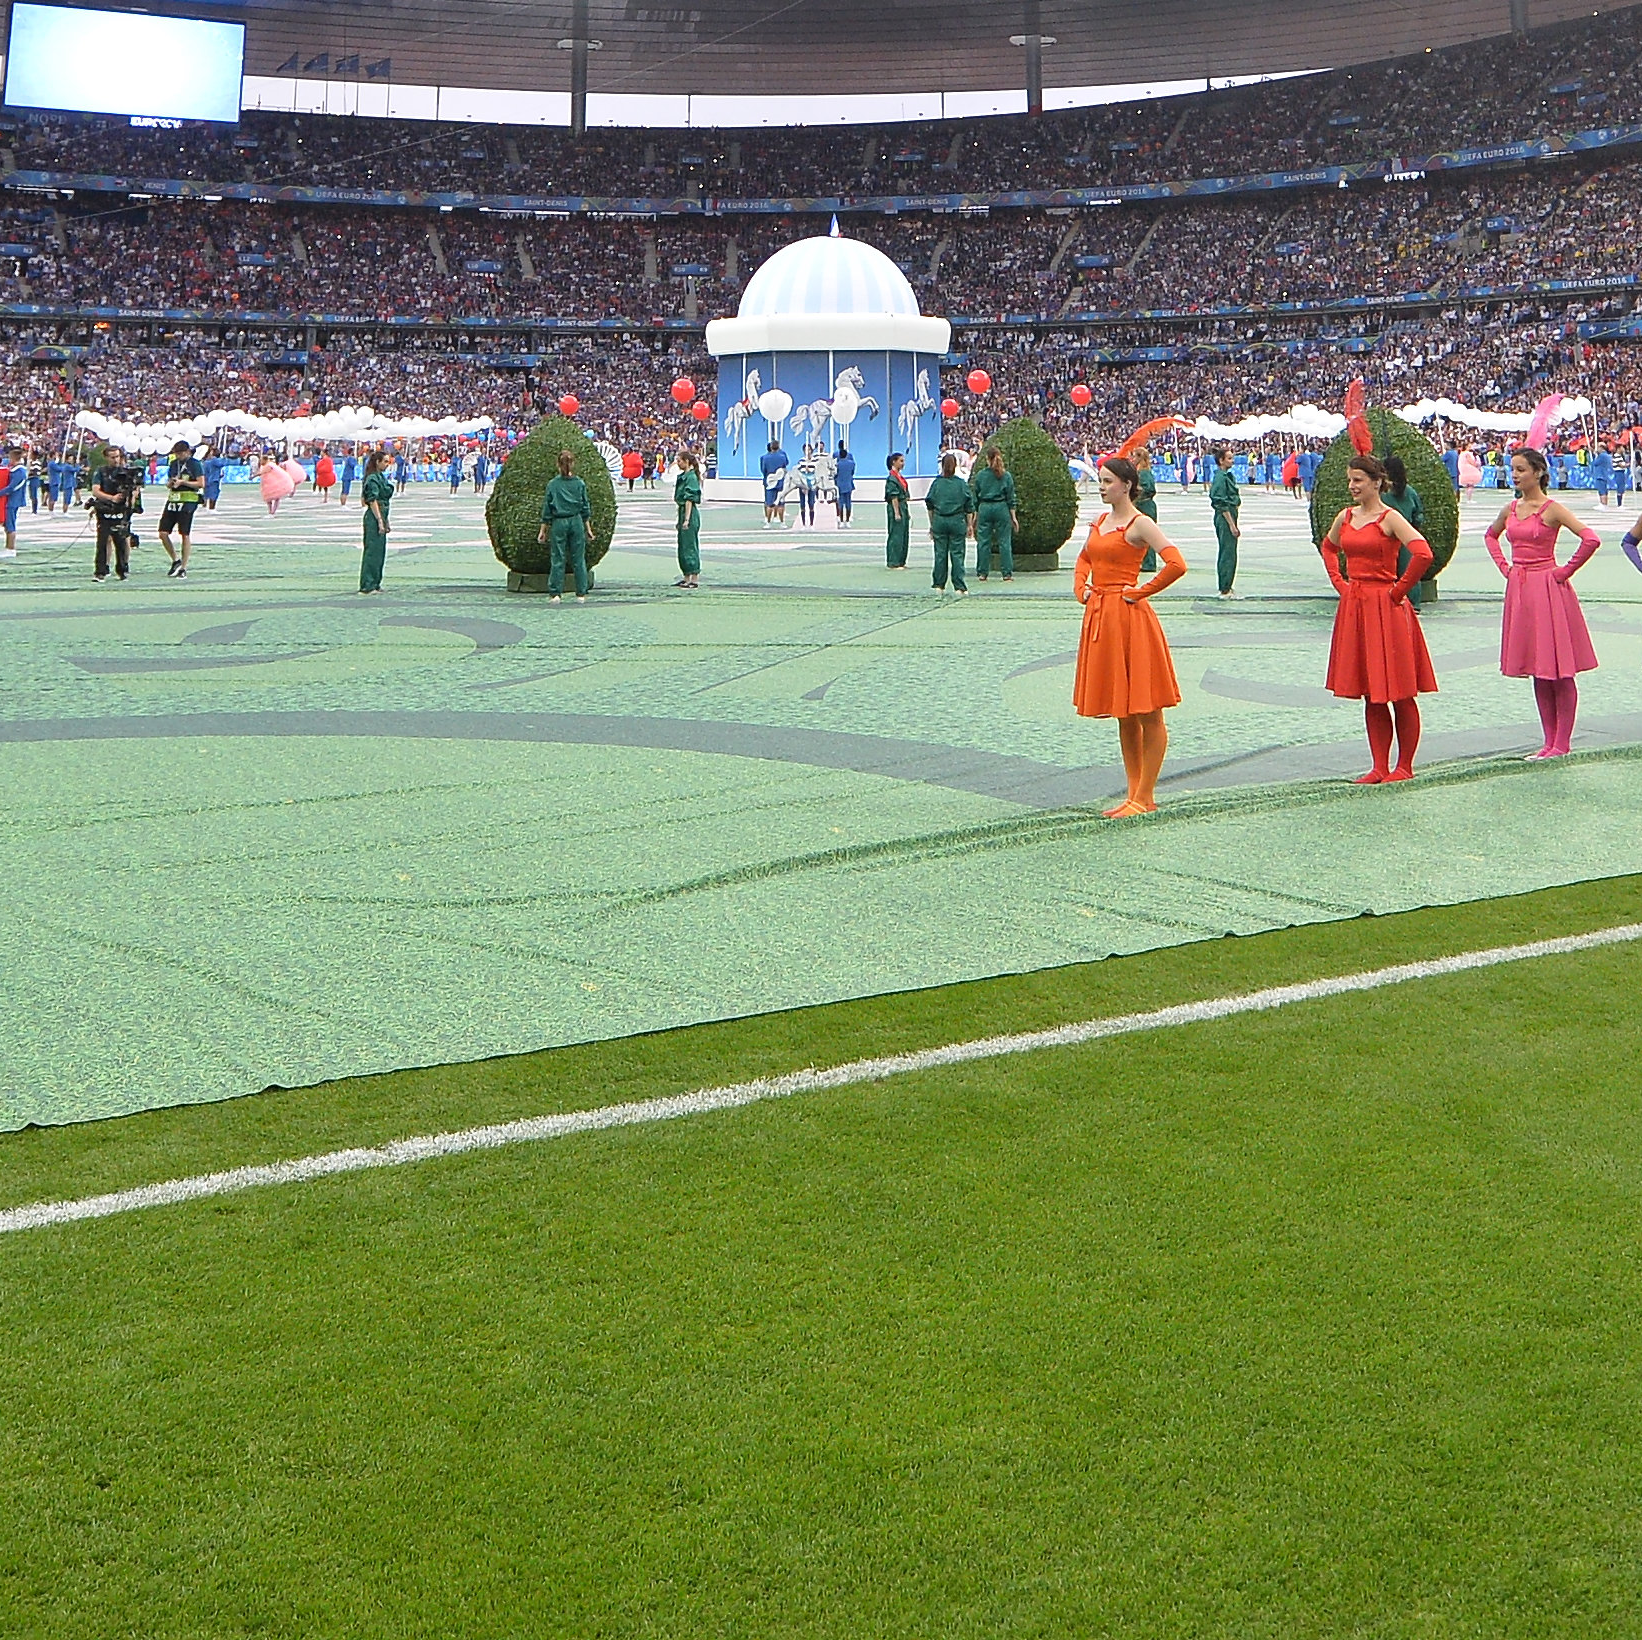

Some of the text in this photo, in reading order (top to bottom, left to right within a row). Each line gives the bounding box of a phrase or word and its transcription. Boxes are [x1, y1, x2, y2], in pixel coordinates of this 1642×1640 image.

[1461, 145, 1525, 162] UEFA EURO 2016
[1283, 172, 1327, 183] SAINT-DENIS
[1562, 277, 1627, 289] UEFA EURO 2016
[118, 309, 164, 317] SAINT-DENIS
